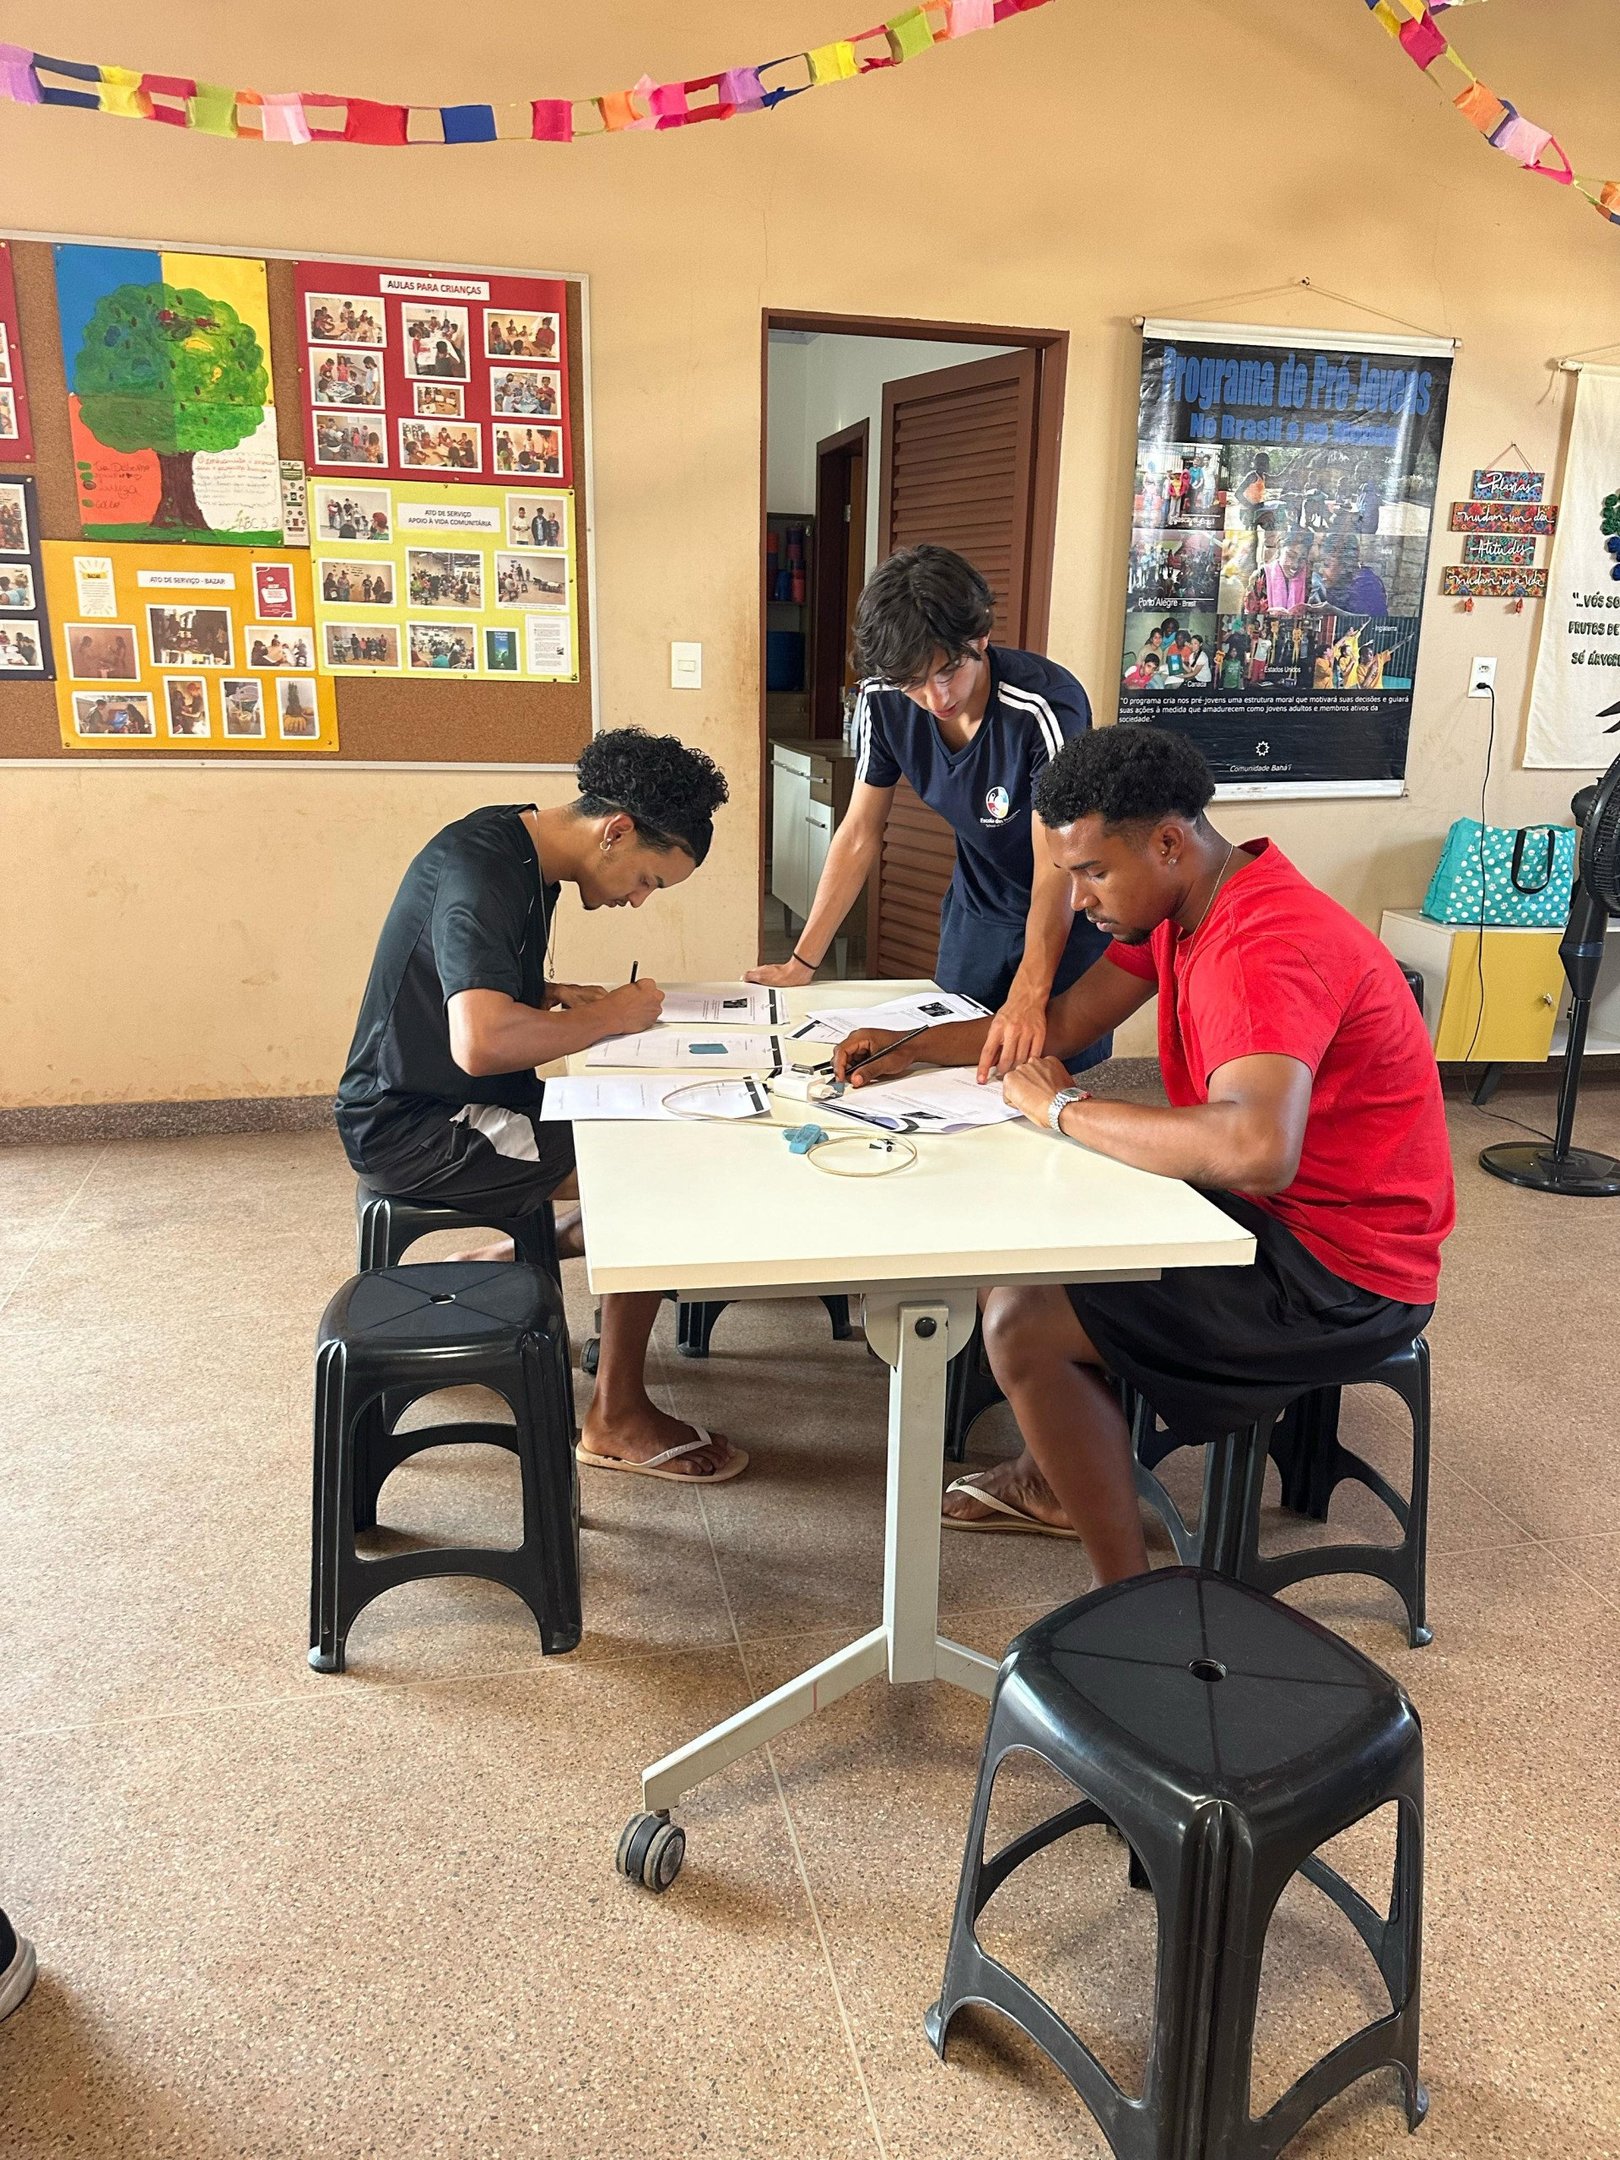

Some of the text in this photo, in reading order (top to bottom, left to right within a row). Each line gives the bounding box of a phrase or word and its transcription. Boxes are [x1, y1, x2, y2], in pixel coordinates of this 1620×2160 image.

[387, 280, 482, 295] AULAS PARA CRIANÇAS
[1162, 346, 1433, 416] Programa de Pré-Jovens
[1190, 413, 1217, 438] No
[1221, 414, 1282, 441] Brasil
[1285, 422, 1299, 441] e
[1457, 506, 1554, 523] mudam um dia
[1470, 540, 1534, 557] Atitudes
[1138, 597, 1155, 608] Porto
[1155, 597, 1178, 608] Alegre
[1568, 621, 1605, 636] FRUTOS
[1130, 698, 1161, 706] programa
[1191, 696, 1226, 705] pré-jovens
[1309, 695, 1337, 703] motivará
[1355, 695, 1381, 703] decisões
[1388, 695, 1409, 704] guiará
[1135, 706, 1154, 715] ações
[1162, 705, 1187, 713] medida
[1188, 706, 1201, 714] que
[1202, 705, 1245, 713] amadurecem
[1265, 705, 1287, 714] jovens
[1288, 704, 1312, 712] adultos
[1319, 704, 1349, 712] membros
[1350, 704, 1369, 712] ativos
[1230, 764, 1270, 772] Comunidade
